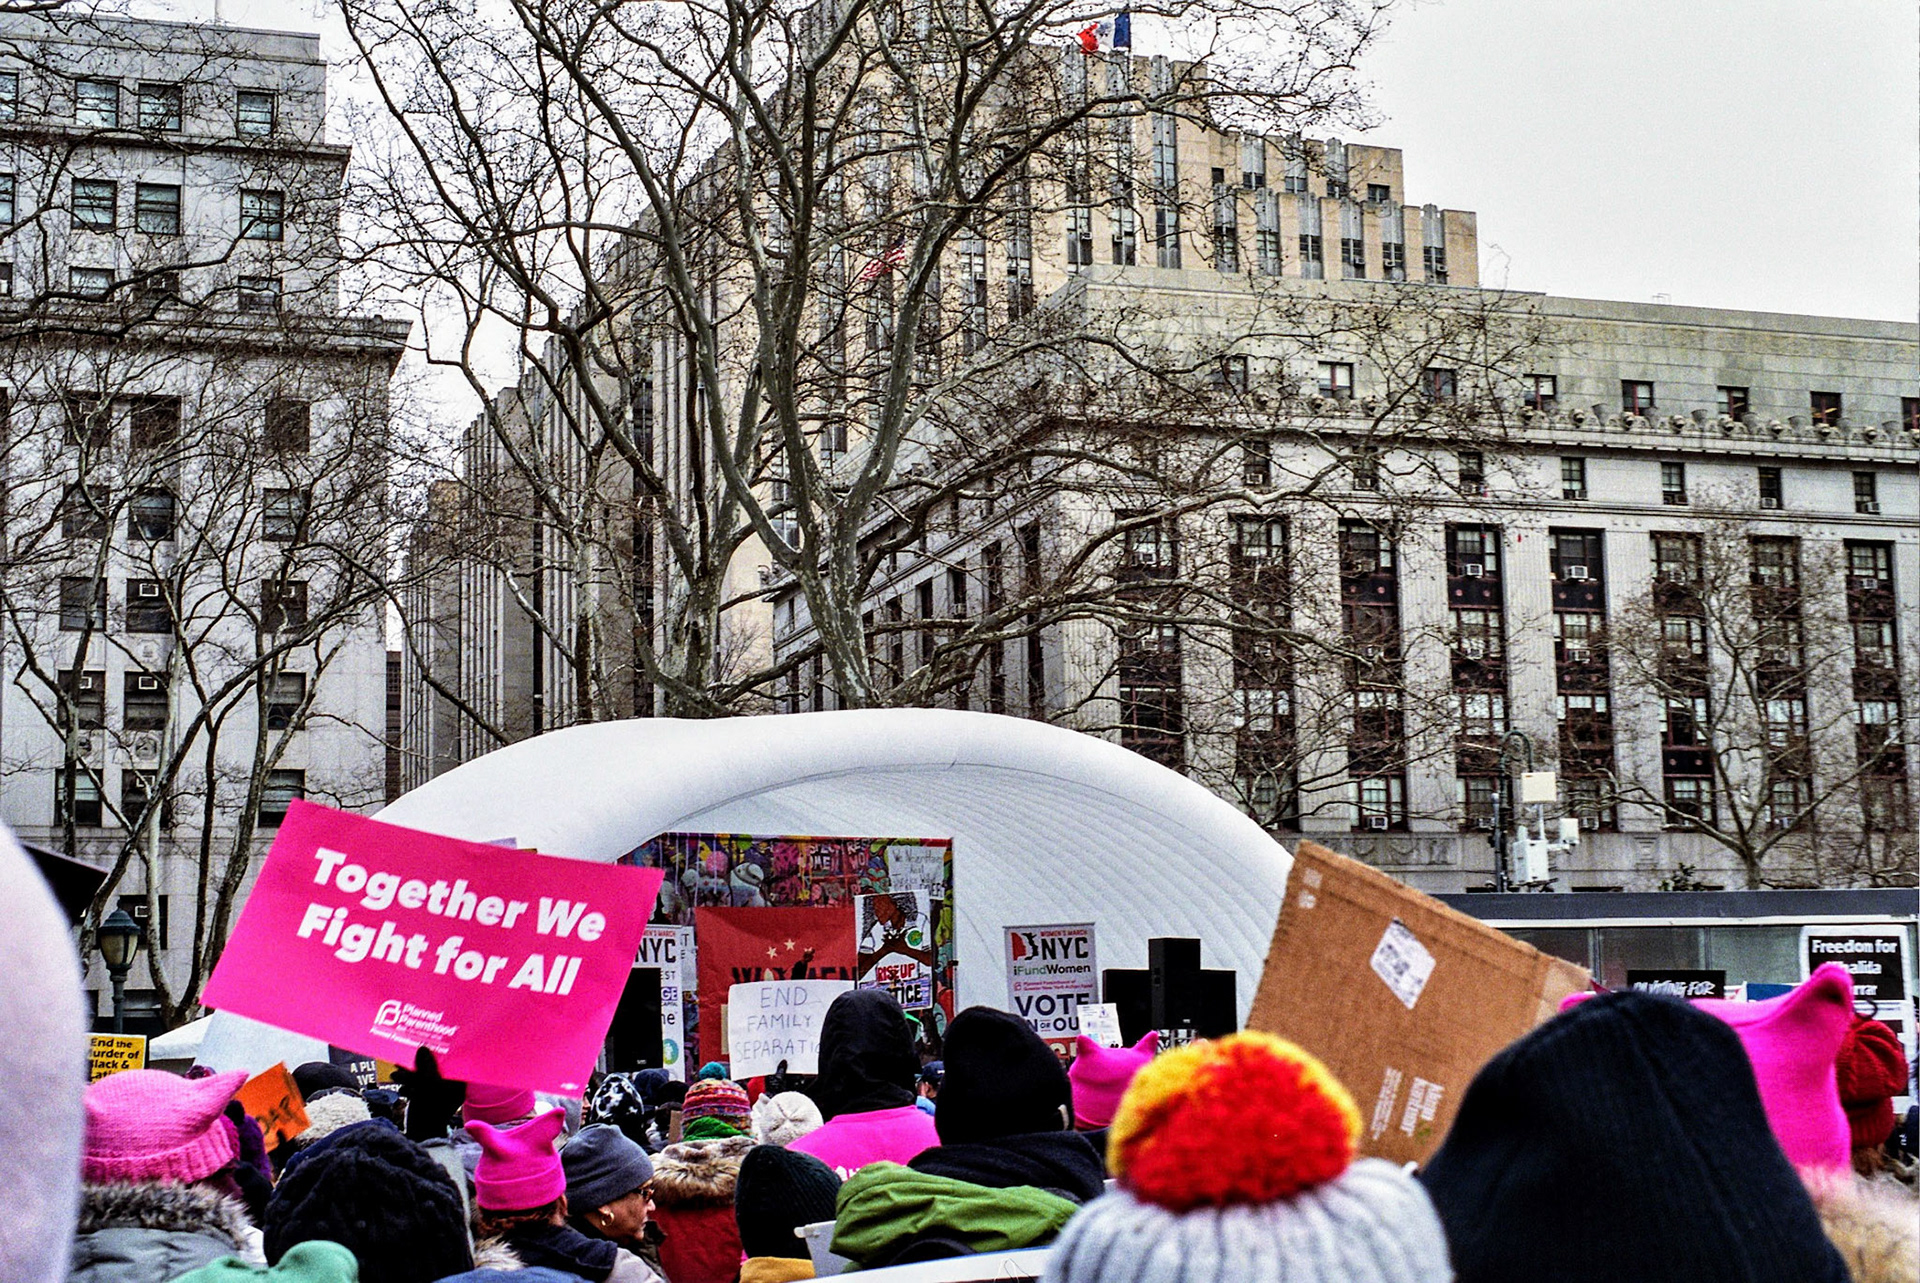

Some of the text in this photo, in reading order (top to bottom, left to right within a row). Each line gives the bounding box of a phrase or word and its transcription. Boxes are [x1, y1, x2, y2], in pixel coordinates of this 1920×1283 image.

[313, 847, 606, 942] Together We
[297, 902, 583, 996] Fight for All
[635, 937, 677, 963] NYC
[1041, 936, 1089, 960] NYC
[1811, 938, 1897, 954] Freedom for
[1013, 963, 1091, 976] iFundWomen
[760, 986, 808, 1009] END
[1014, 993, 1090, 1017] VOTE
[402, 1003, 443, 1023] Planned
[747, 1013, 811, 1032] FAMILY
[398, 1013, 457, 1037] Parenthood
[1053, 1016, 1079, 1032] OU
[91, 1037, 133, 1048] End the
[121, 1060, 130, 1070] &
[127, 1050, 140, 1060] of
